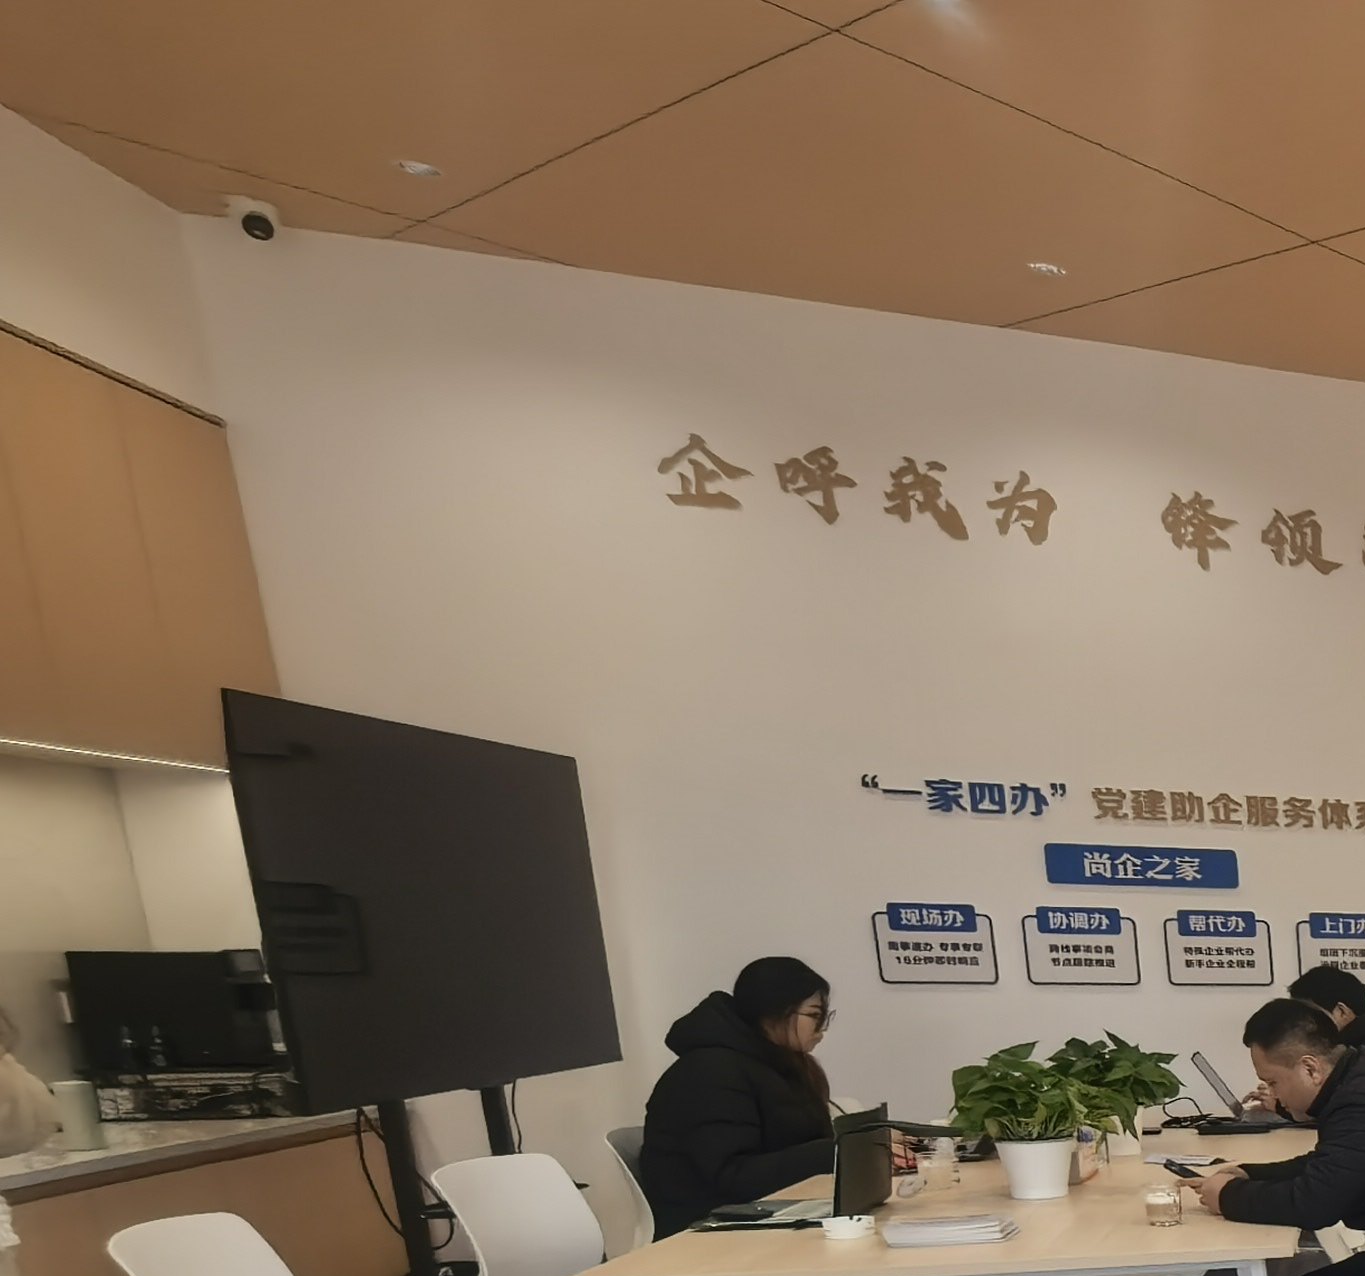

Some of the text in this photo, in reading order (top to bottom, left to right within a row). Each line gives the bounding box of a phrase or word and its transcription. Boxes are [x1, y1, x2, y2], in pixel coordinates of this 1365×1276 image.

[657, 432, 1058, 546] 企呼我为
[861, 774, 1067, 816] “一家四办”
[1083, 852, 1202, 881] 尚企之家
[899, 908, 965, 928] 现场办
[1048, 911, 1110, 930] 协调办
[1188, 915, 1246, 933] 帮代办
